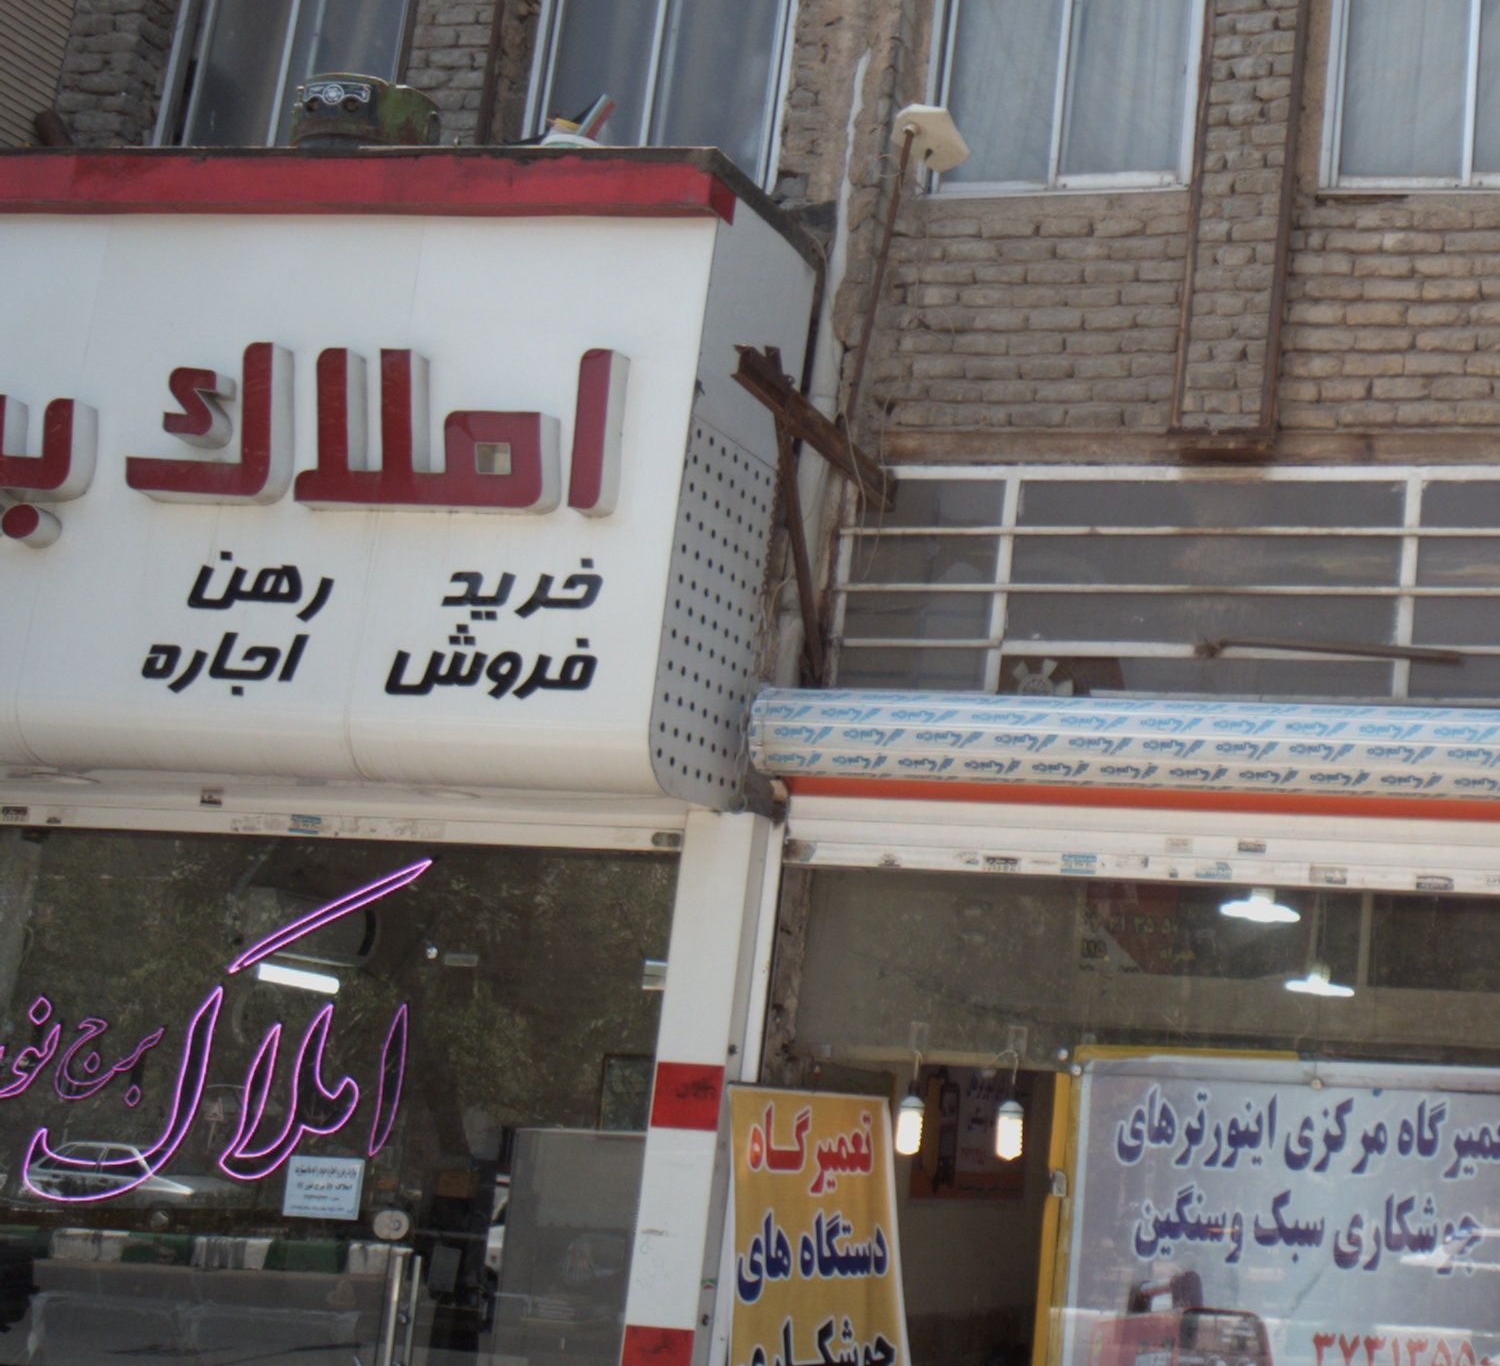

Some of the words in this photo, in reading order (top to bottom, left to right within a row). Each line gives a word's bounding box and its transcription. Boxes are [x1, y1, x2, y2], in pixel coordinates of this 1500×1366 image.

[125, 341, 630, 516] املاک
[187, 550, 335, 622] رهن
[442, 557, 604, 620] خرید
[141, 632, 311, 697] اجاره
[385, 623, 598, 700] فروش
[0, 996, 62, 1099] نو
[1283, 1096, 1389, 1175] مرکزی
[738, 1211, 792, 1303] های
[799, 1211, 888, 1278] دستگاه
[1253, 1189, 1325, 1265] سبک
[1333, 1193, 1482, 1276] جوشکاری
